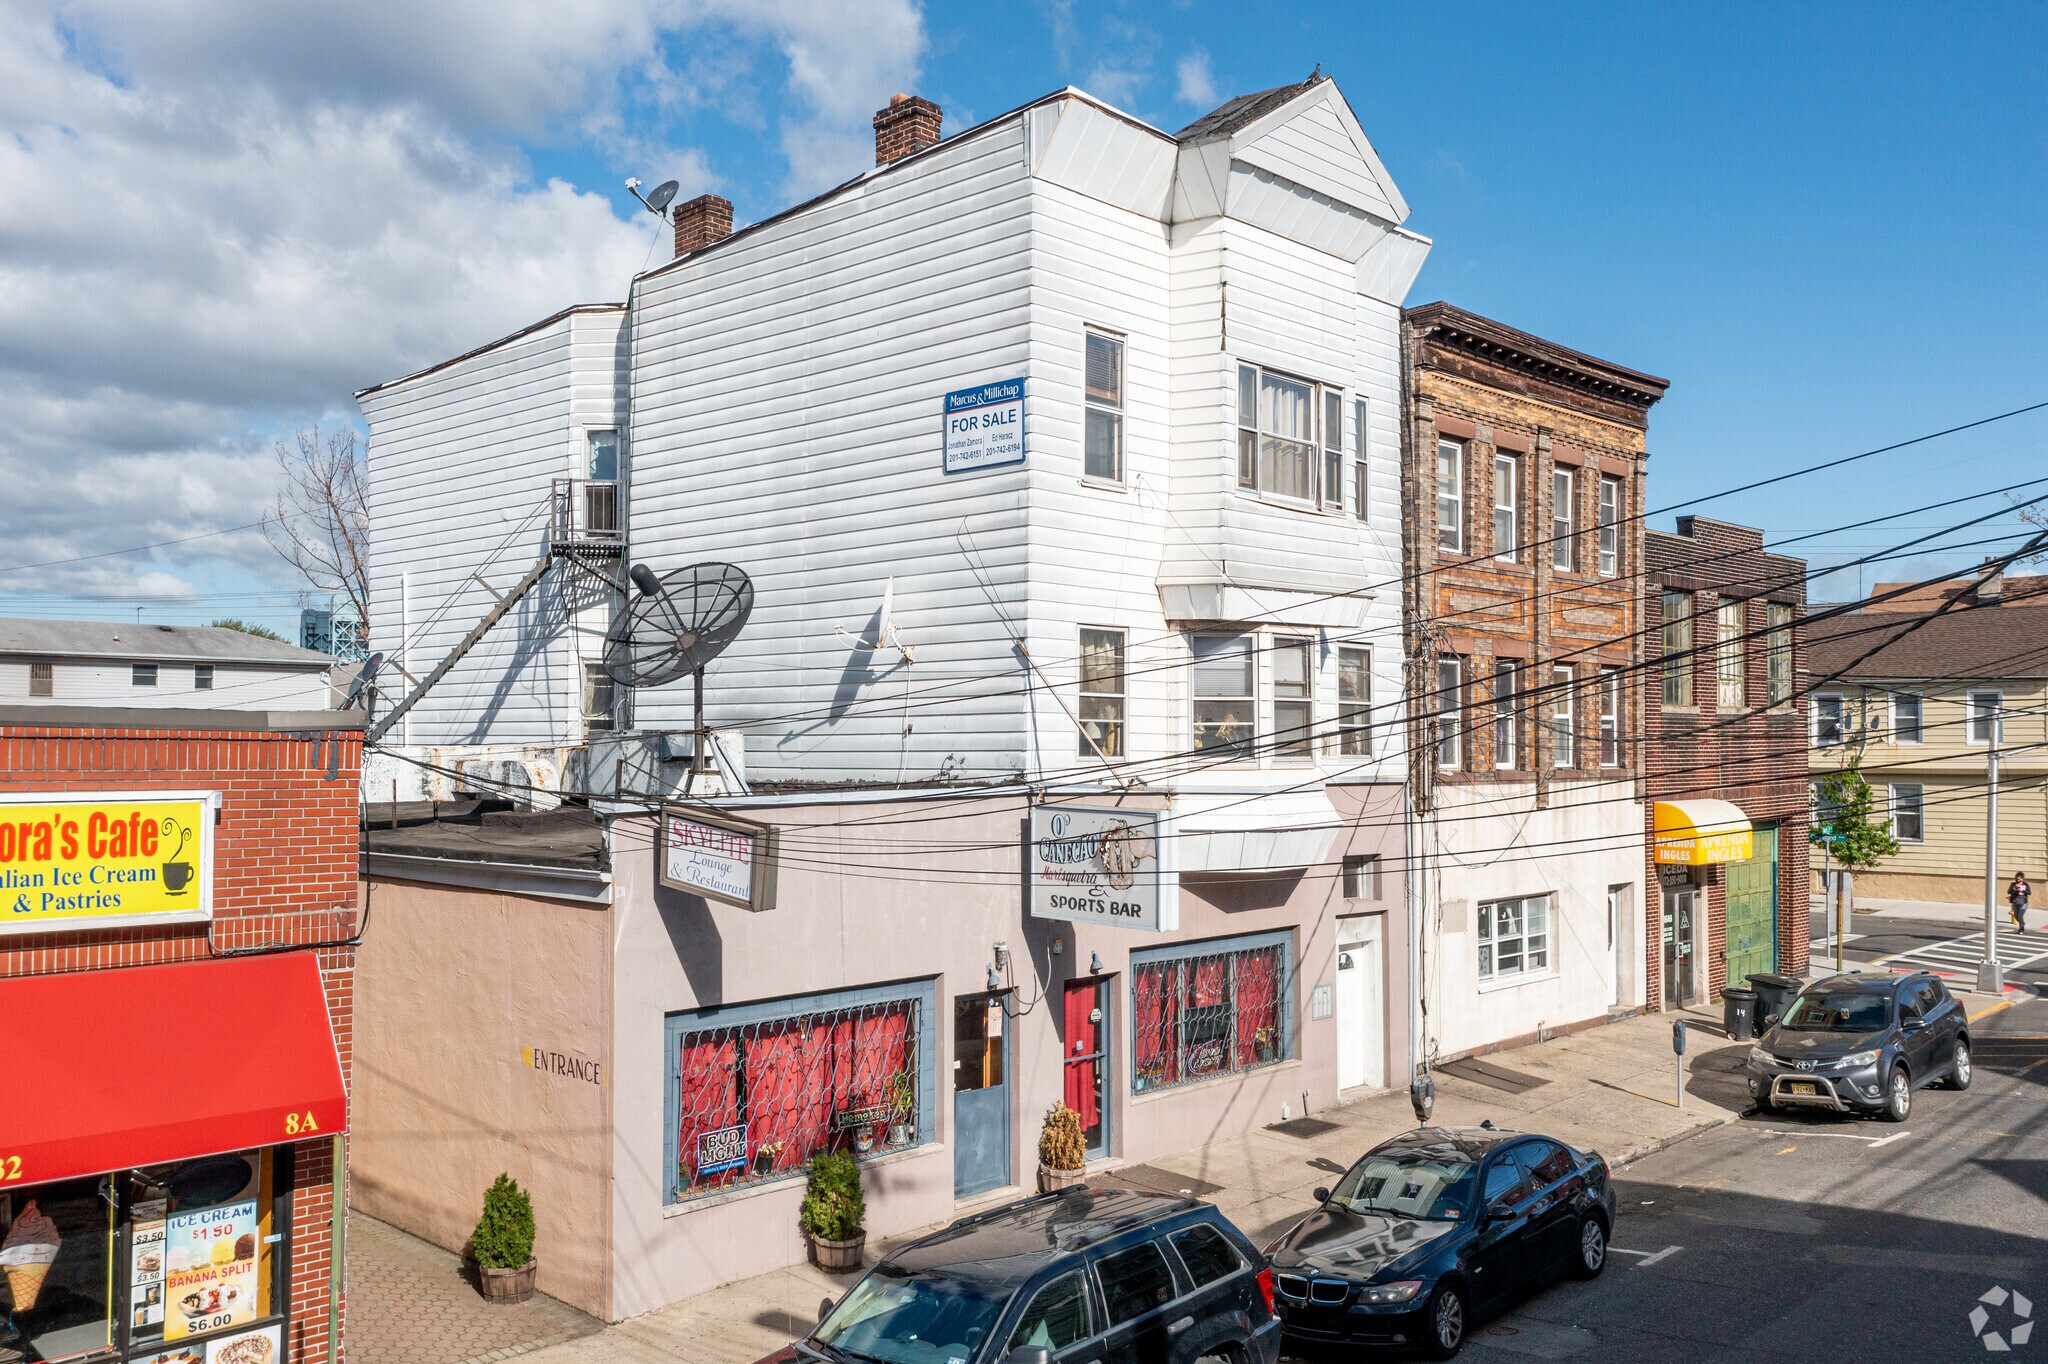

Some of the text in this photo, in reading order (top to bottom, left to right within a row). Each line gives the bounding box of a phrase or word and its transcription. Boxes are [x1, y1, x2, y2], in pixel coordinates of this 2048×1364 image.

[950, 384, 1019, 407] Marcus & Millichap
[952, 408, 1016, 434] FOR SALE
[87, 811, 159, 859] Cafe
[672, 820, 750, 865] SKYLITE
[1655, 836, 1696, 848] APRENDA
[1700, 832, 1749, 849] APRENDA
[689, 850, 732, 878] Lounge
[1660, 850, 1691, 861] INGLES
[1707, 846, 1743, 863] INGLES
[52, 867, 82, 886] Ice
[89, 865, 156, 884] Cream
[670, 862, 750, 898] & Restaurant
[13, 890, 121, 913] & Pastries
[1050, 894, 1142, 918] SPORTS BAR
[1736, 1008, 1746, 1018] 14
[534, 1048, 600, 1084] ENTRANCE
[286, 1110, 320, 1134] 8A
[707, 1130, 740, 1150] BUD
[701, 1142, 746, 1164] LIGHT
[172, 1204, 254, 1230] ICE CREAM
[136, 1232, 164, 1244] $3.50
[192, 1224, 233, 1240] $1.50
[137, 1272, 160, 1282] $3.50
[168, 1262, 252, 1288] BANANA SPLIT
[188, 1313, 232, 1333] $6.00
